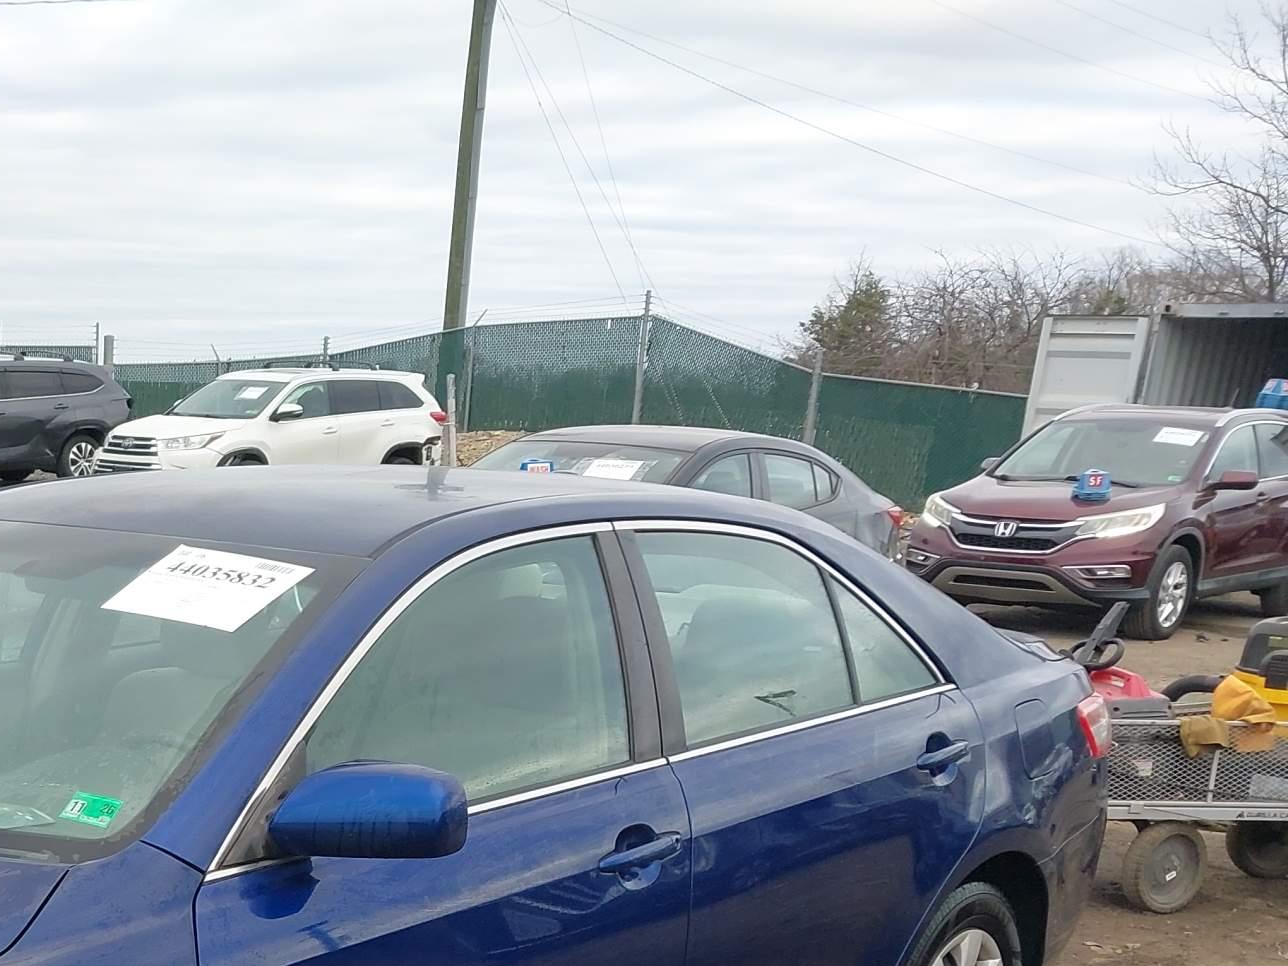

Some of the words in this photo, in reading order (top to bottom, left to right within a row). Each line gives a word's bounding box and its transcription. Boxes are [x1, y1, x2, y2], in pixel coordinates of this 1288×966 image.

[1088, 476, 1103, 486] SF
[166, 561, 276, 588] 44035832
[70, 801, 86, 813] 11
[100, 804, 115, 815] 26
